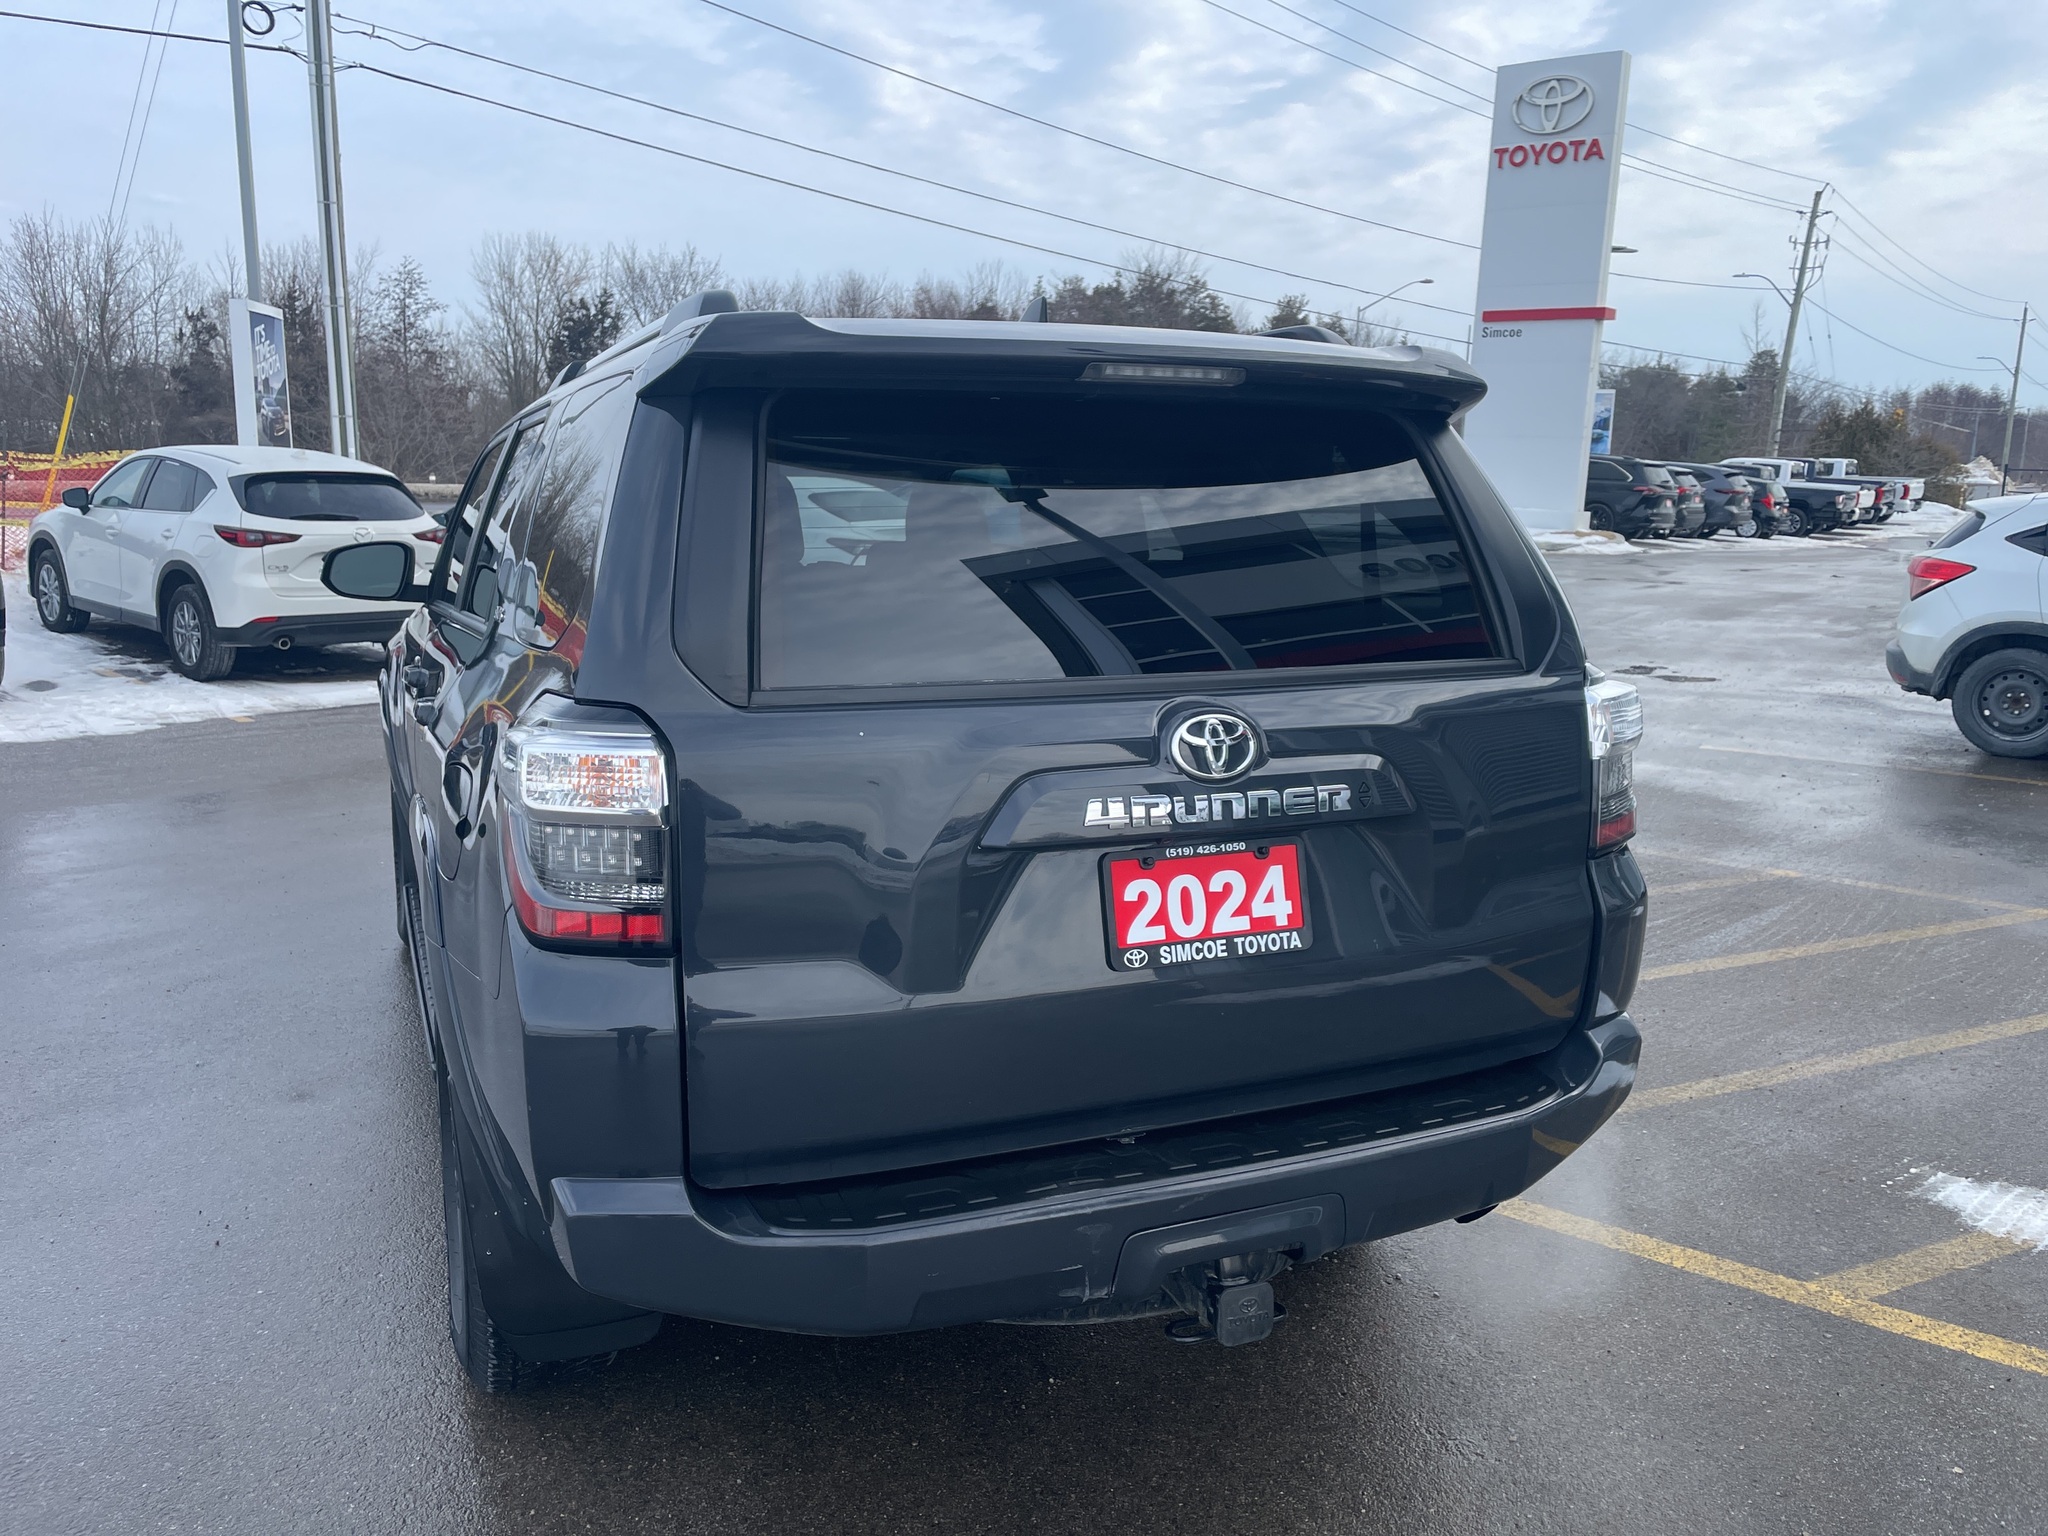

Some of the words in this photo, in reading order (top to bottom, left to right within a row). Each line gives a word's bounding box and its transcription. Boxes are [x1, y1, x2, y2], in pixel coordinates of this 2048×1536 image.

[1494, 138, 1604, 169] TOYOTA
[1481, 326, 1522, 338] Simcoe
[257, 353, 280, 382] TOYOTA
[1165, 846, 1194, 857] (519)
[1196, 842, 1246, 854] 426-1050
[1123, 864, 1293, 944] 2024
[1159, 938, 1228, 965] SIMCOE
[1234, 931, 1302, 955] TOYOTA
[1227, 1311, 1269, 1328] TOYOTA
